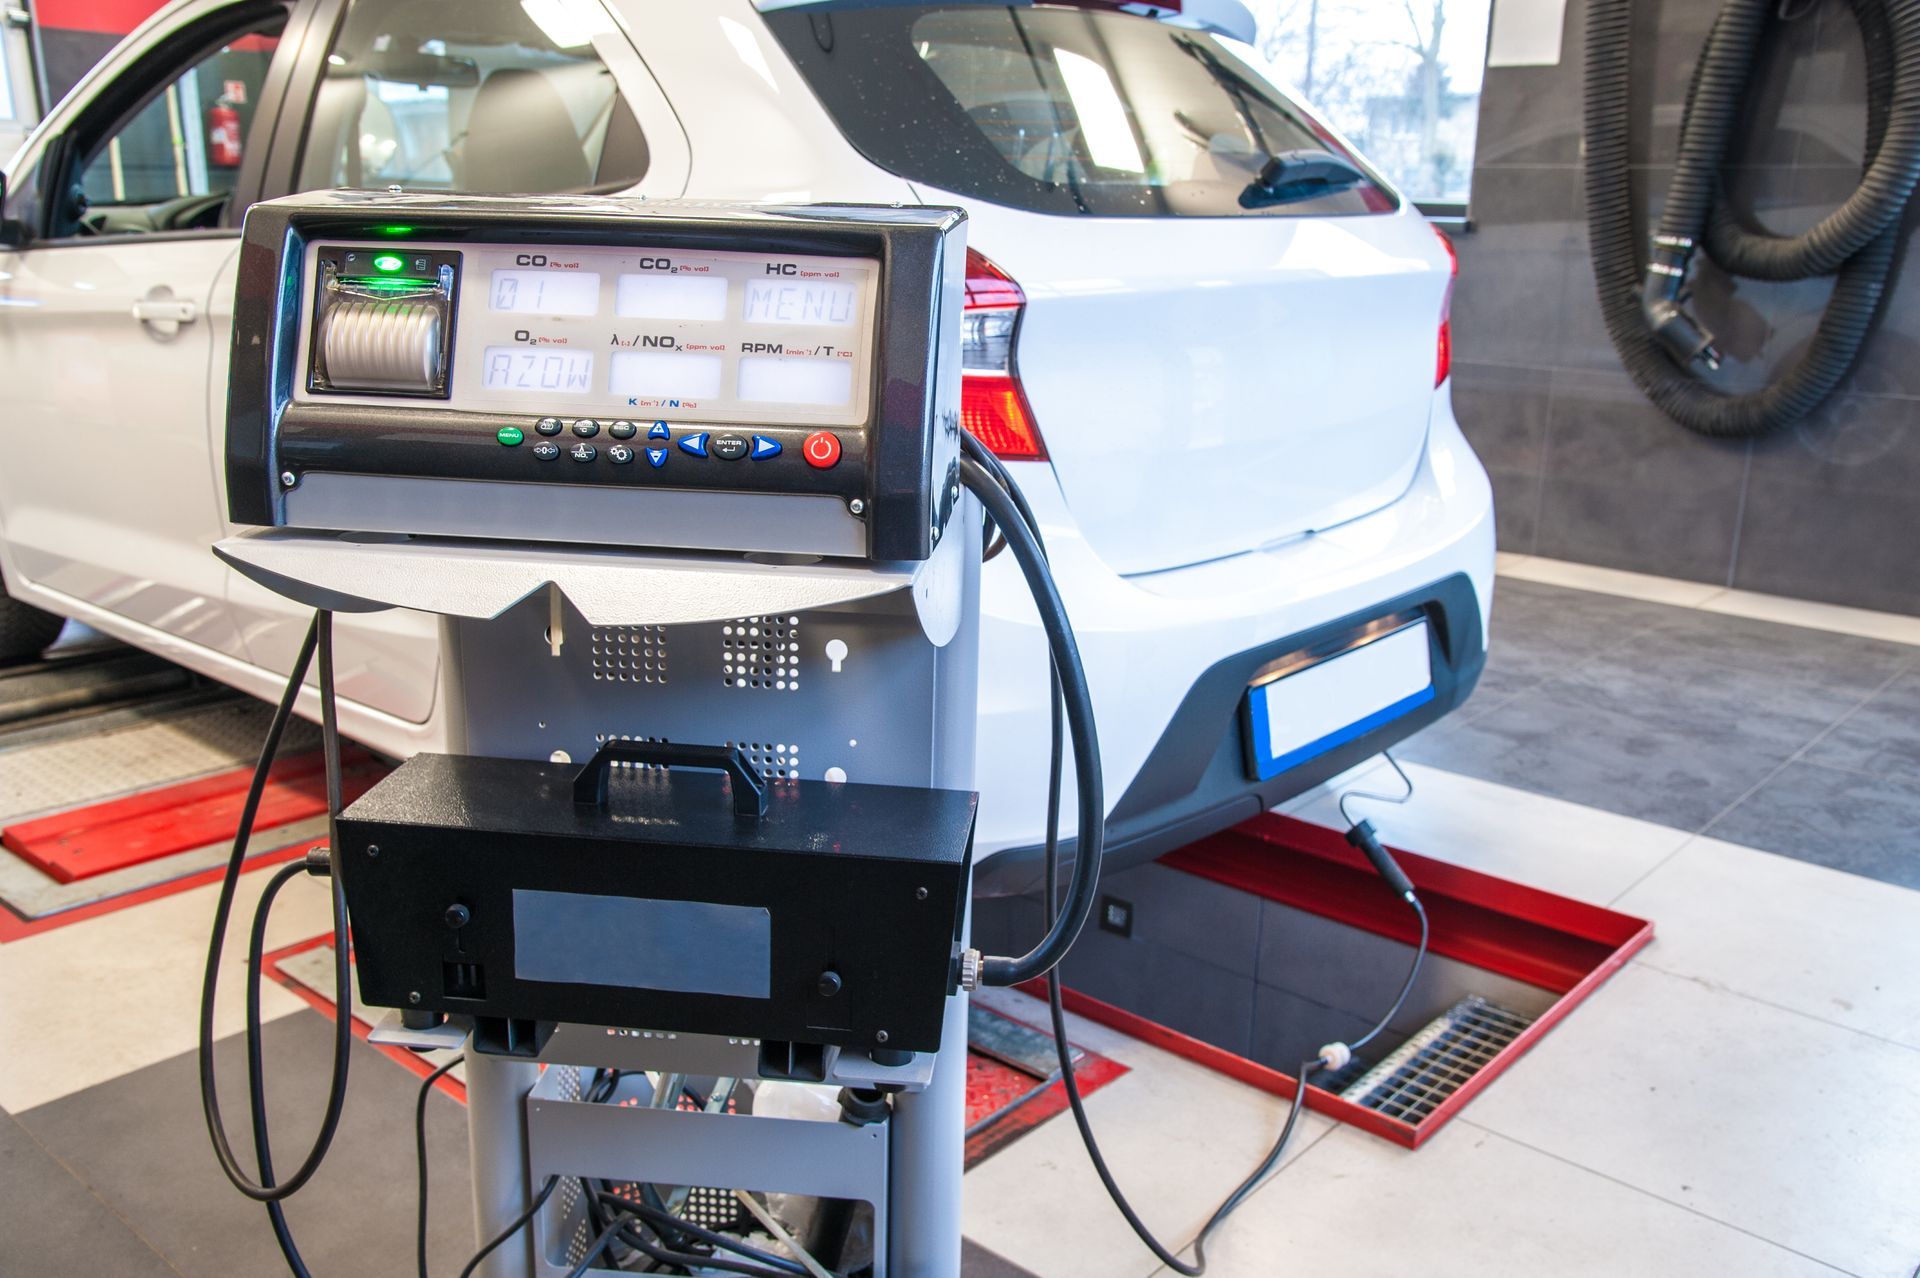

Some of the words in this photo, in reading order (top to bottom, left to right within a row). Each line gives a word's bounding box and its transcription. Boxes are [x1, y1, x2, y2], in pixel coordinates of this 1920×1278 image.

[516, 254, 547, 267] CO
[765, 262, 797, 276] HC
[748, 287, 852, 322] MENU
[741, 342, 783, 354] RPM
[488, 354, 591, 389] AZOW
[628, 398, 638, 406] K
[669, 400, 680, 408] N
